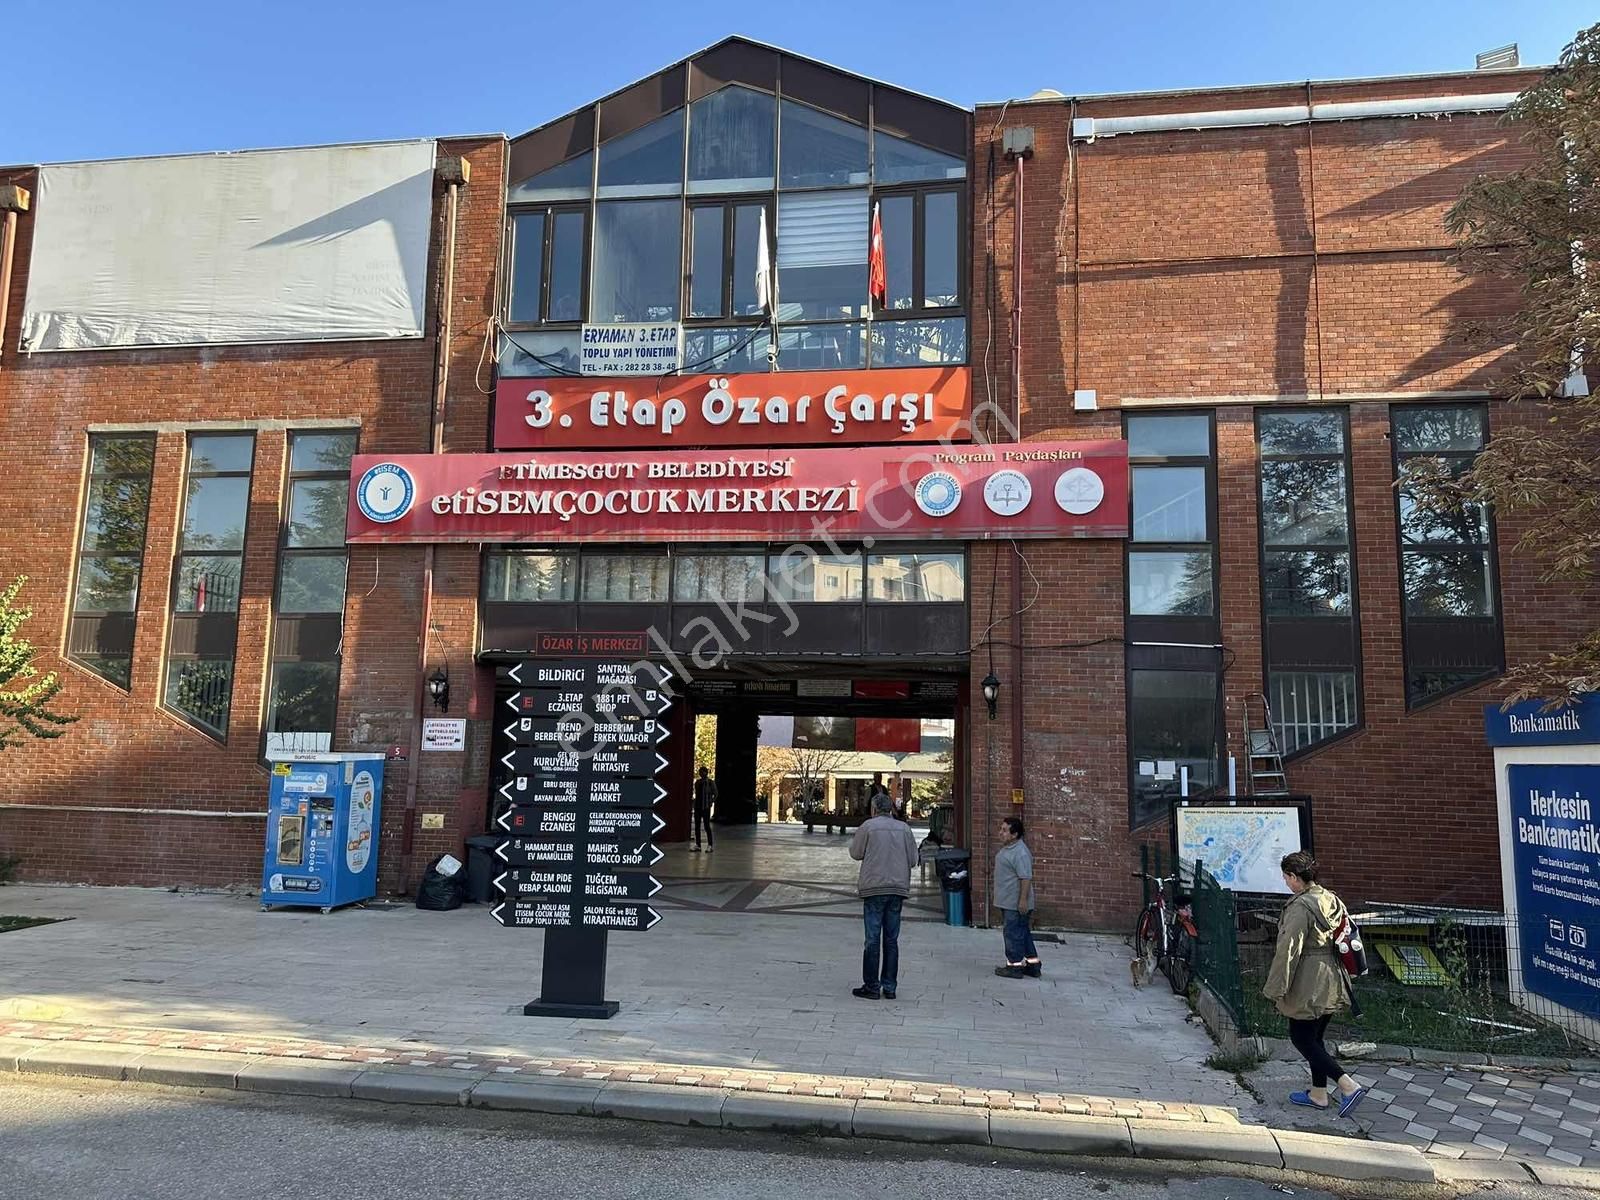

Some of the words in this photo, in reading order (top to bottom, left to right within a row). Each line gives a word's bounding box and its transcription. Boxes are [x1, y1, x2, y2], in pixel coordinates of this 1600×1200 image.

[584, 328, 635, 343] ERYAMAN
[640, 327, 677, 342] 3.ETAP
[583, 348, 610, 358] TOPLU
[613, 348, 632, 358] YAPI
[635, 344, 677, 358] YÖNETİMİ
[583, 364, 597, 372] TEL
[603, 363, 619, 371] FAX
[625, 363, 639, 371] 282
[641, 363, 651, 371] 28
[524, 389, 573, 428] 3.
[589, 389, 686, 435] Etap
[701, 378, 811, 426] Özar
[825, 385, 935, 434] Çarşı
[935, 452, 996, 465] Program
[1004, 449, 1082, 463] Paydaşları
[499, 459, 640, 480] ETİMESGUT
[648, 456, 796, 479] BELEDİYESİ
[542, 635, 573, 650] ÖZAR
[577, 636, 588, 653] İŞ
[592, 636, 643, 651] MERKEZİ
[597, 664, 631, 674] SANTRAL
[596, 673, 637, 685] MAĞAZASI
[558, 693, 583, 703] 3.ETAP
[596, 694, 614, 703] 1881
[616, 694, 631, 703] PET
[547, 702, 583, 713] ECZANESİ
[595, 703, 617, 713] SHOP
[1509, 709, 1581, 734] Bankamatik
[556, 722, 582, 732] TREND
[534, 732, 562, 741] BERBER
[564, 731, 581, 742] SAİT
[593, 733, 617, 743] ERKEK
[618, 731, 649, 744] KUAFÖR
[592, 752, 618, 762] ALKIM
[592, 762, 630, 772] KIRTASİYE
[543, 780, 558, 788] EBRU
[534, 794, 553, 802] BAYAN
[589, 792, 622, 802] MARKET
[1530, 790, 1590, 821] Herkesin
[543, 811, 576, 822] BENGİSU
[540, 822, 576, 832] ECZANESİ
[524, 843, 555, 851] HAMARAT
[556, 843, 574, 852] ELLER
[527, 852, 536, 860] EV
[586, 853, 620, 863] TOBACCO
[622, 854, 643, 864] SHOP
[530, 871, 555, 882] ÖZLEM
[556, 873, 573, 882] PİDE
[585, 872, 617, 885] TUĞÇEM
[518, 883, 541, 892] KEBAP
[542, 884, 572, 893] SALONU
[584, 885, 628, 895] BİLGİSAYAR
[583, 906, 604, 915] SALON
[605, 907, 617, 915] EGE
[624, 907, 637, 916] BUZ
[535, 917, 552, 925] TOPLU
[583, 915, 639, 926] KIRAATHANESİ
